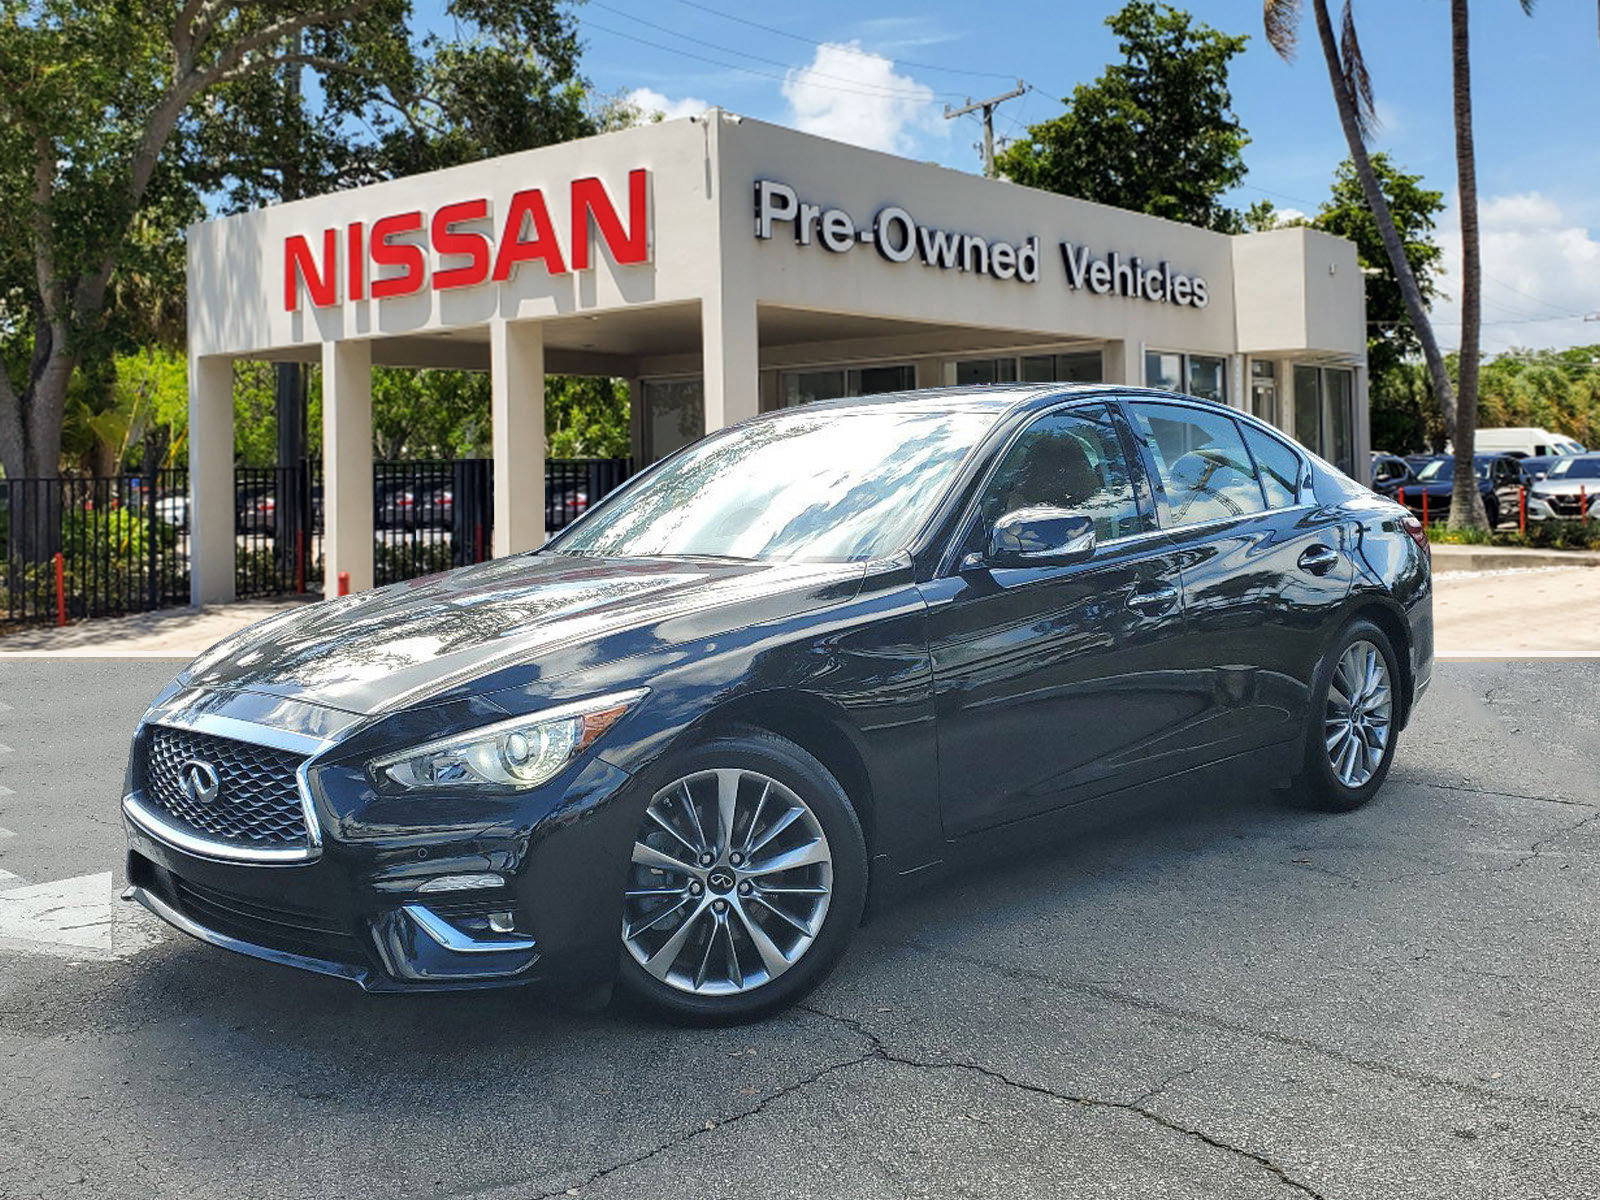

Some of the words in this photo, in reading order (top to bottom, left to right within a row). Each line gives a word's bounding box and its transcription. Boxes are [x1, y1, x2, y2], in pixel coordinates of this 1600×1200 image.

[284, 168, 648, 312] NISSAN
[755, 180, 1040, 283] Pre-Owned
[1060, 241, 1209, 308] Vehicles
